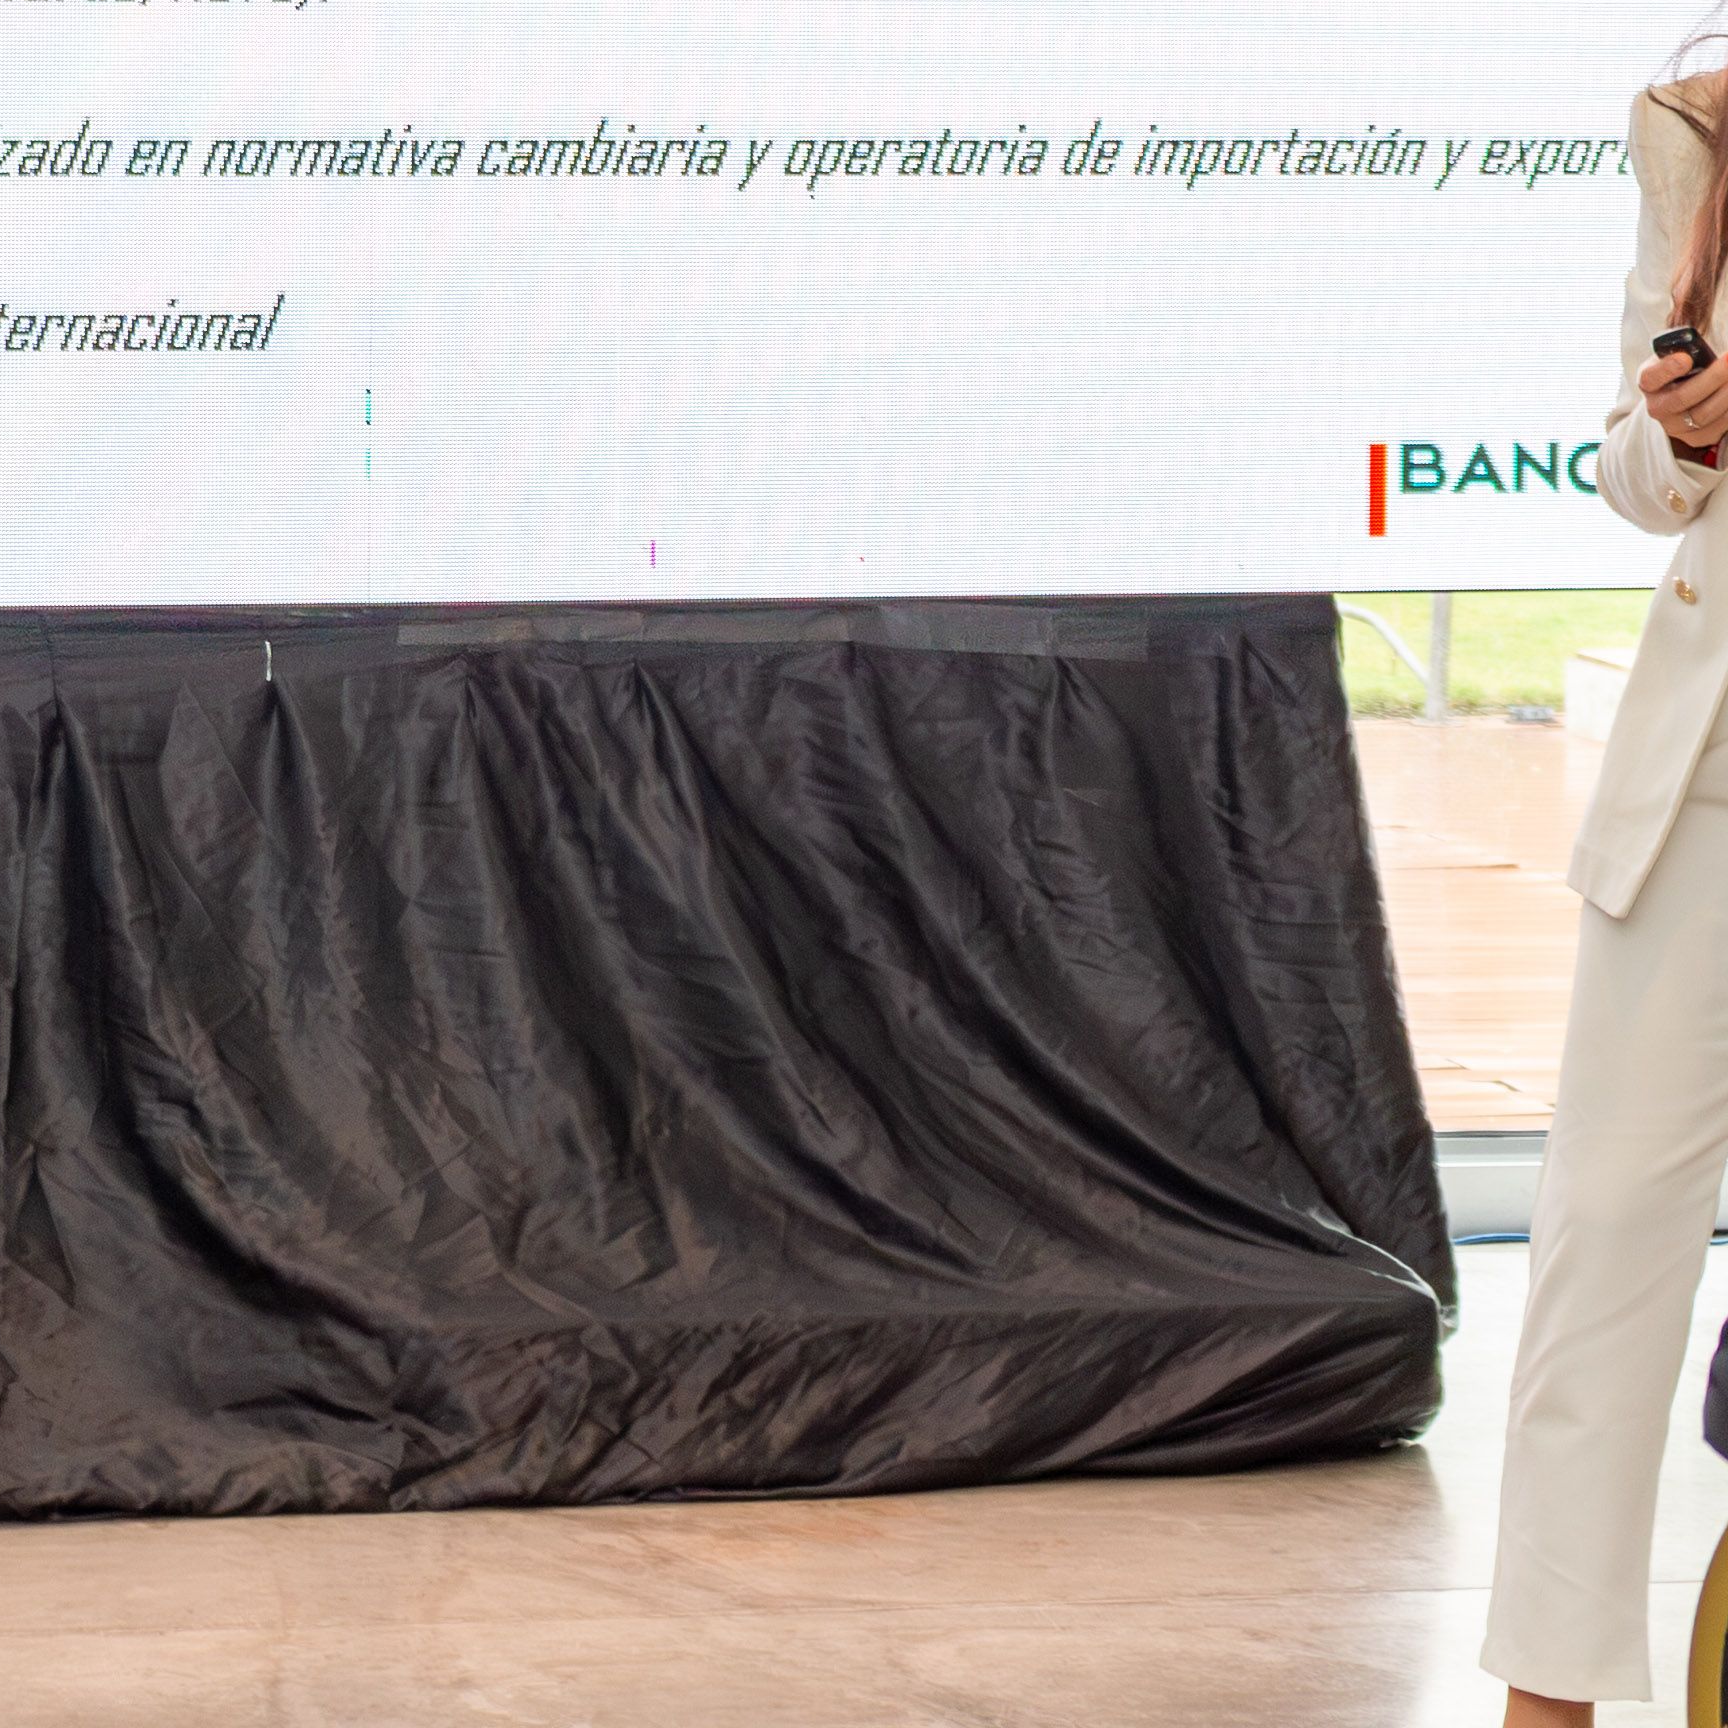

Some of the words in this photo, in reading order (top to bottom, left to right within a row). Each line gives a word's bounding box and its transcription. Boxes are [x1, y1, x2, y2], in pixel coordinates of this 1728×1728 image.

[126, 140, 189, 175] en
[204, 127, 464, 175] normativa
[478, 119, 728, 175] cambiaria
[739, 141, 771, 189] y
[785, 126, 1048, 189] operatoria
[1063, 121, 1122, 174] de
[1135, 126, 1426, 188] importación
[1436, 141, 1468, 188] y
